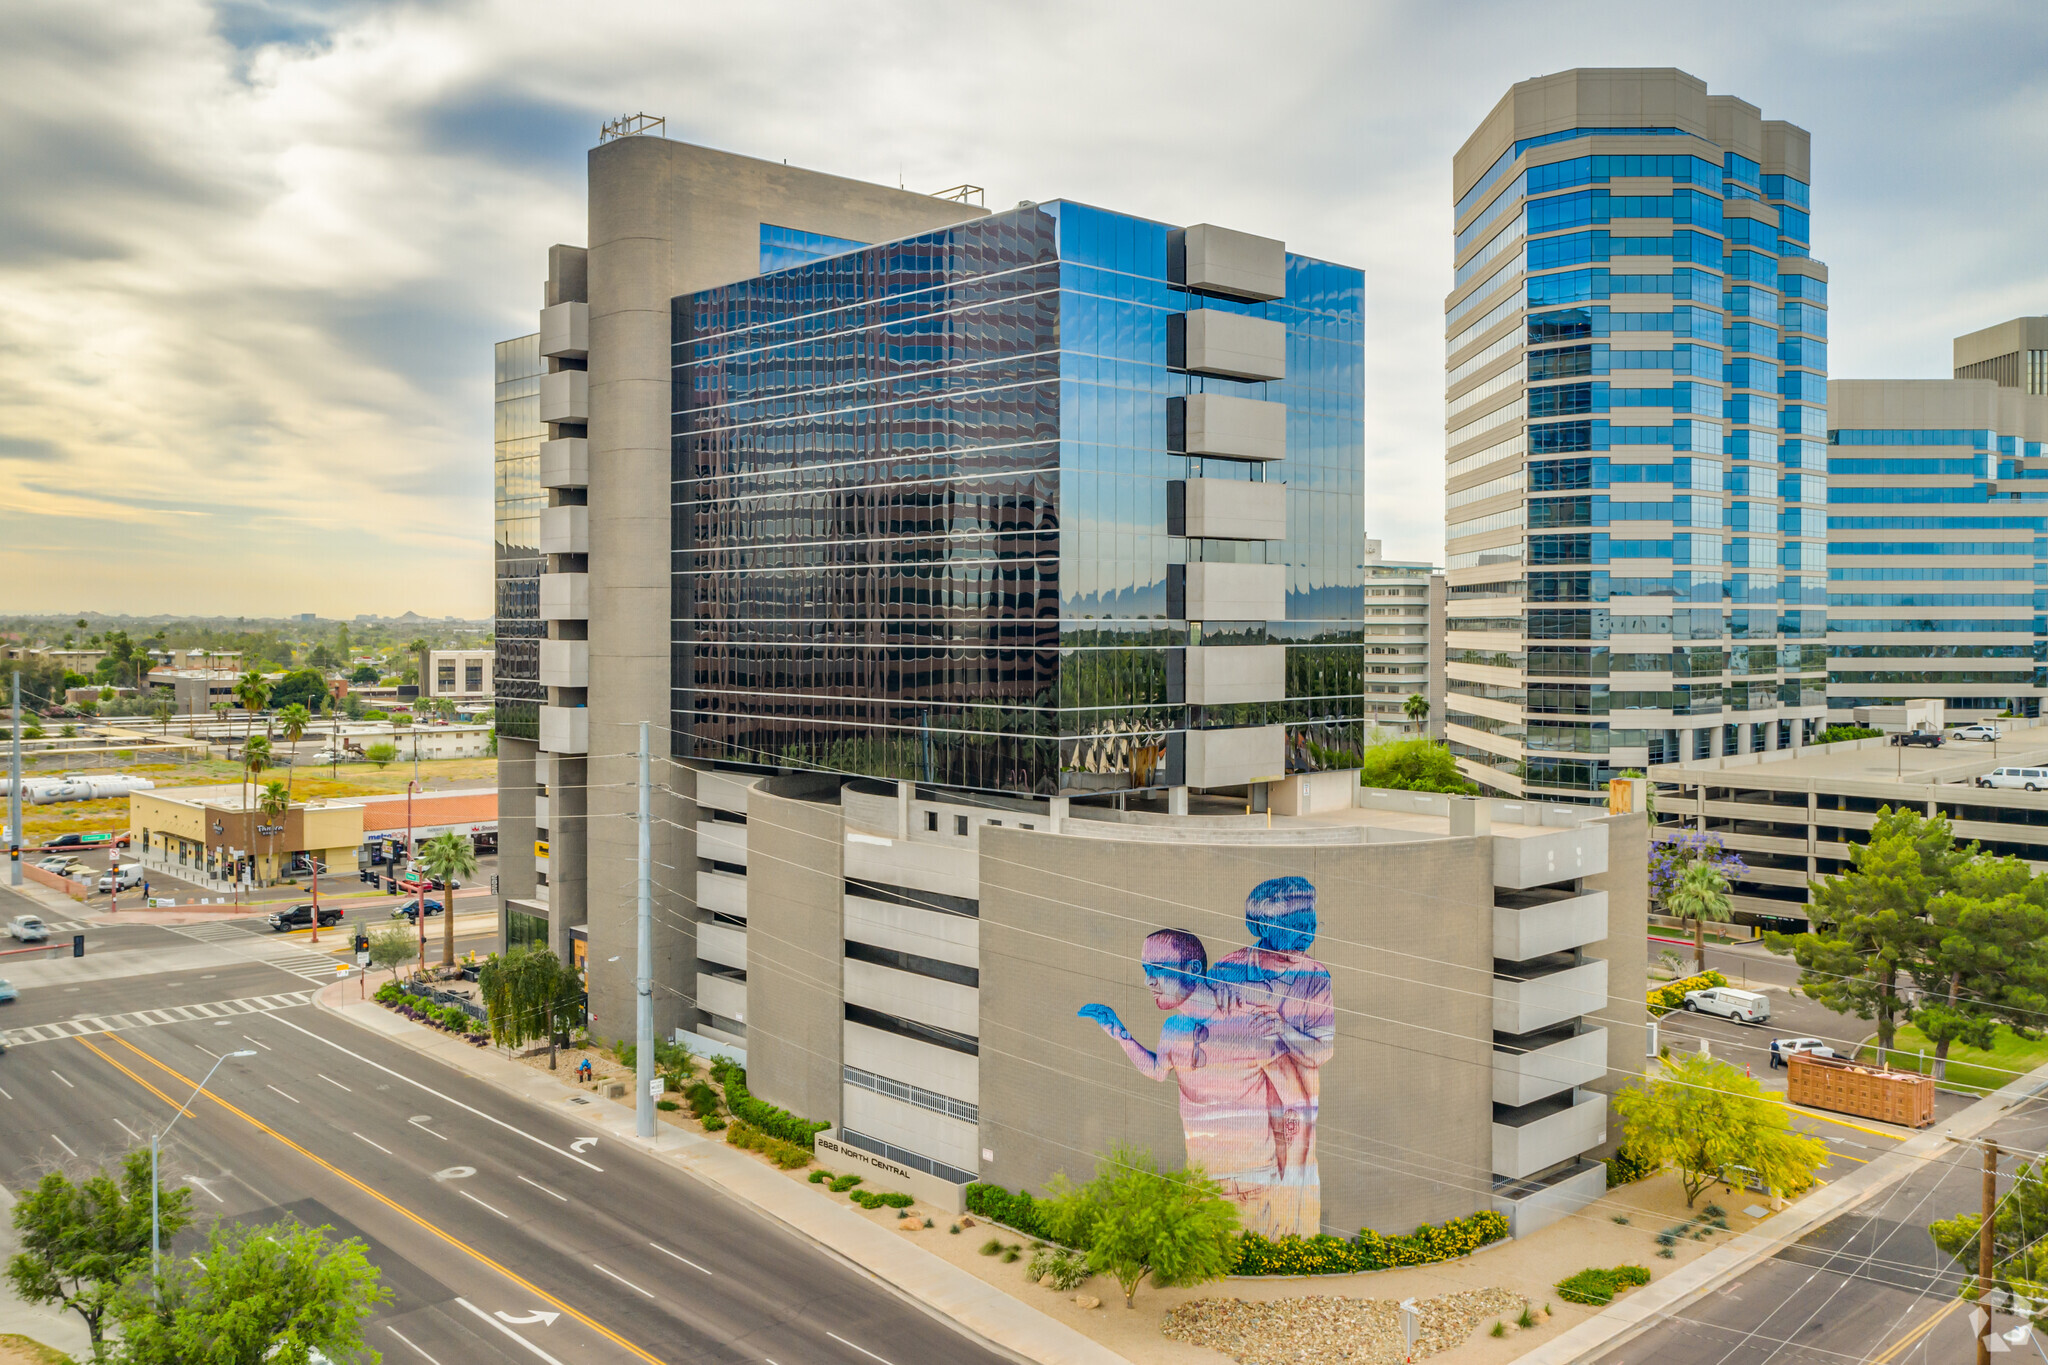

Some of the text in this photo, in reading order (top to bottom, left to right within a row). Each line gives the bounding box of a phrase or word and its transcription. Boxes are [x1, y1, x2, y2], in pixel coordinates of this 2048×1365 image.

[818, 1138, 910, 1179] 2828 NORTH CENTRAL
